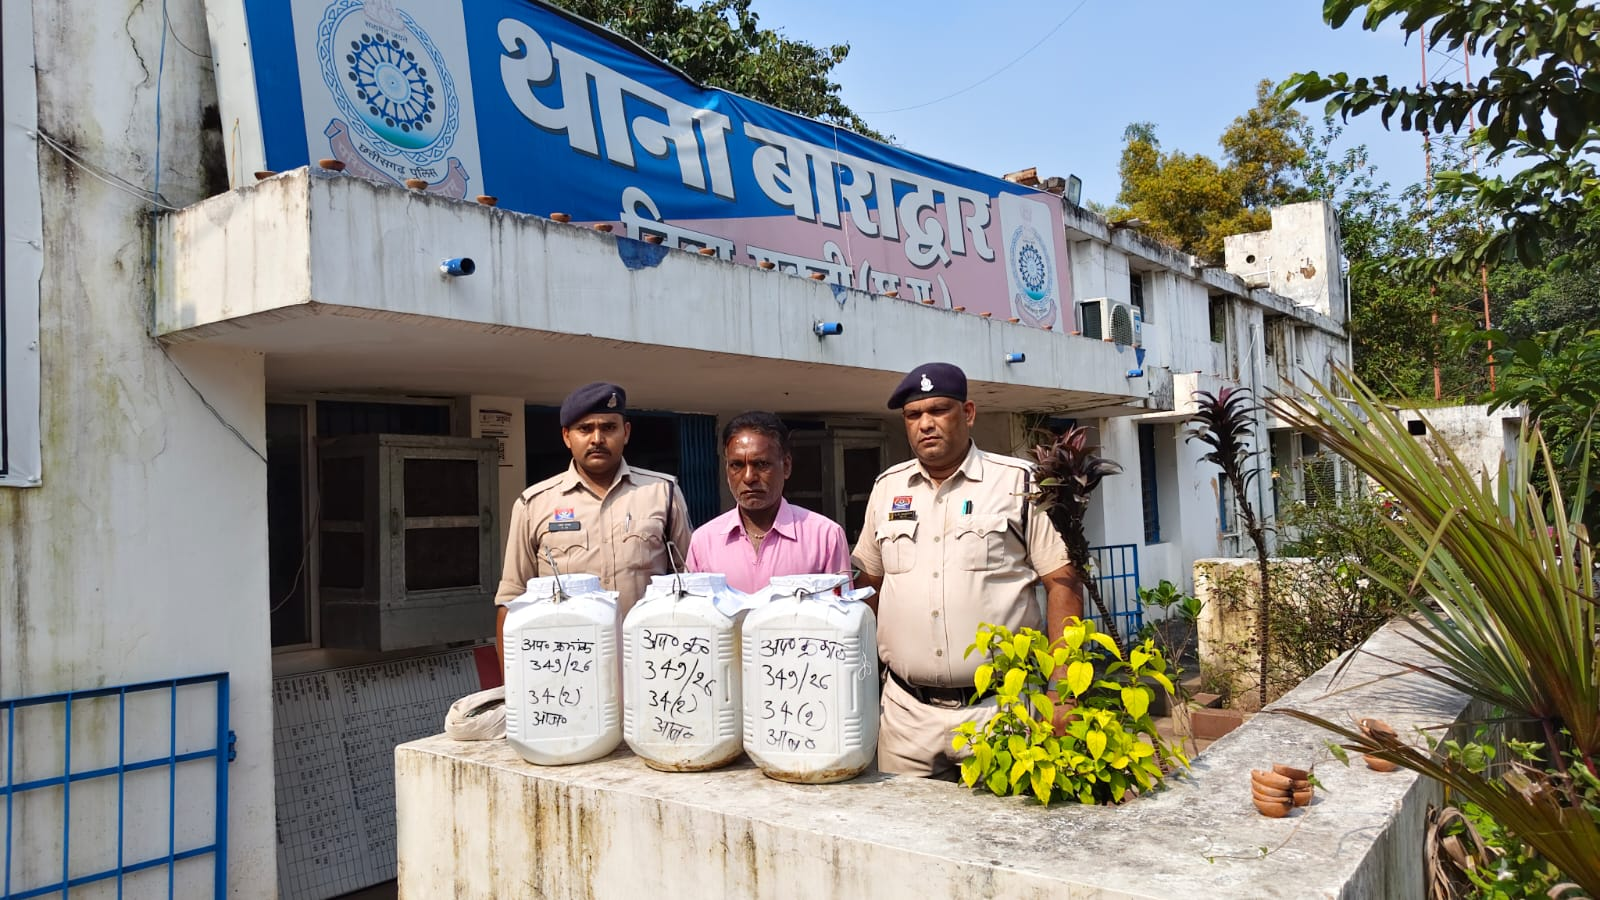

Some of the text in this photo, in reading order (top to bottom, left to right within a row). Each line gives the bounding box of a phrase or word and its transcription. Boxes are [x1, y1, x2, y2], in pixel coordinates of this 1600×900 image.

[497, 18, 735, 201] थाना
[743, 122, 995, 268] बाराद्वार
[530, 652, 593, 677] 349/26
[642, 658, 717, 696] 349/26
[762, 662, 832, 695] 349/26
